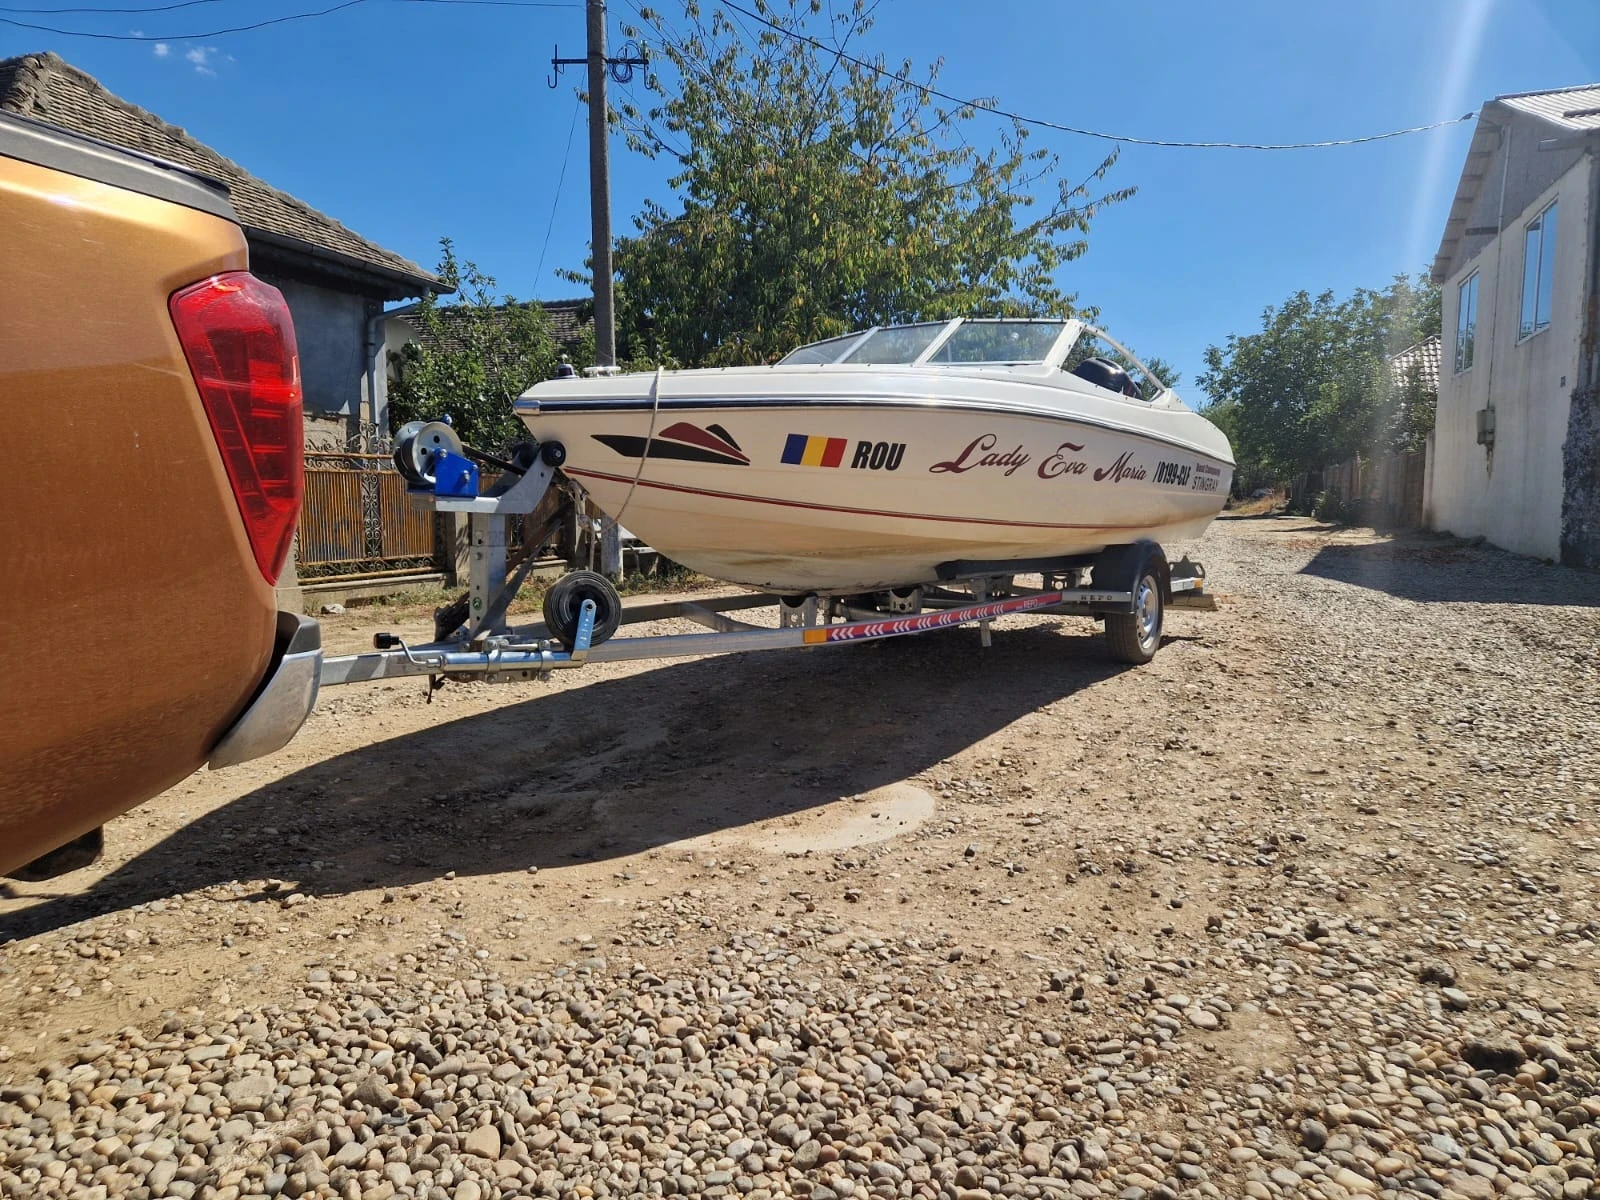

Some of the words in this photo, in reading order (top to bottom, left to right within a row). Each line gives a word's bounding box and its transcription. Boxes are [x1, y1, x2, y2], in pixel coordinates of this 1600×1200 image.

[851, 441, 907, 471] ROU
[929, 433, 1031, 477] Lady
[1037, 442, 1088, 480] Eva
[1093, 451, 1148, 483] Maria
[1191, 475, 1220, 492] STINGRAY
